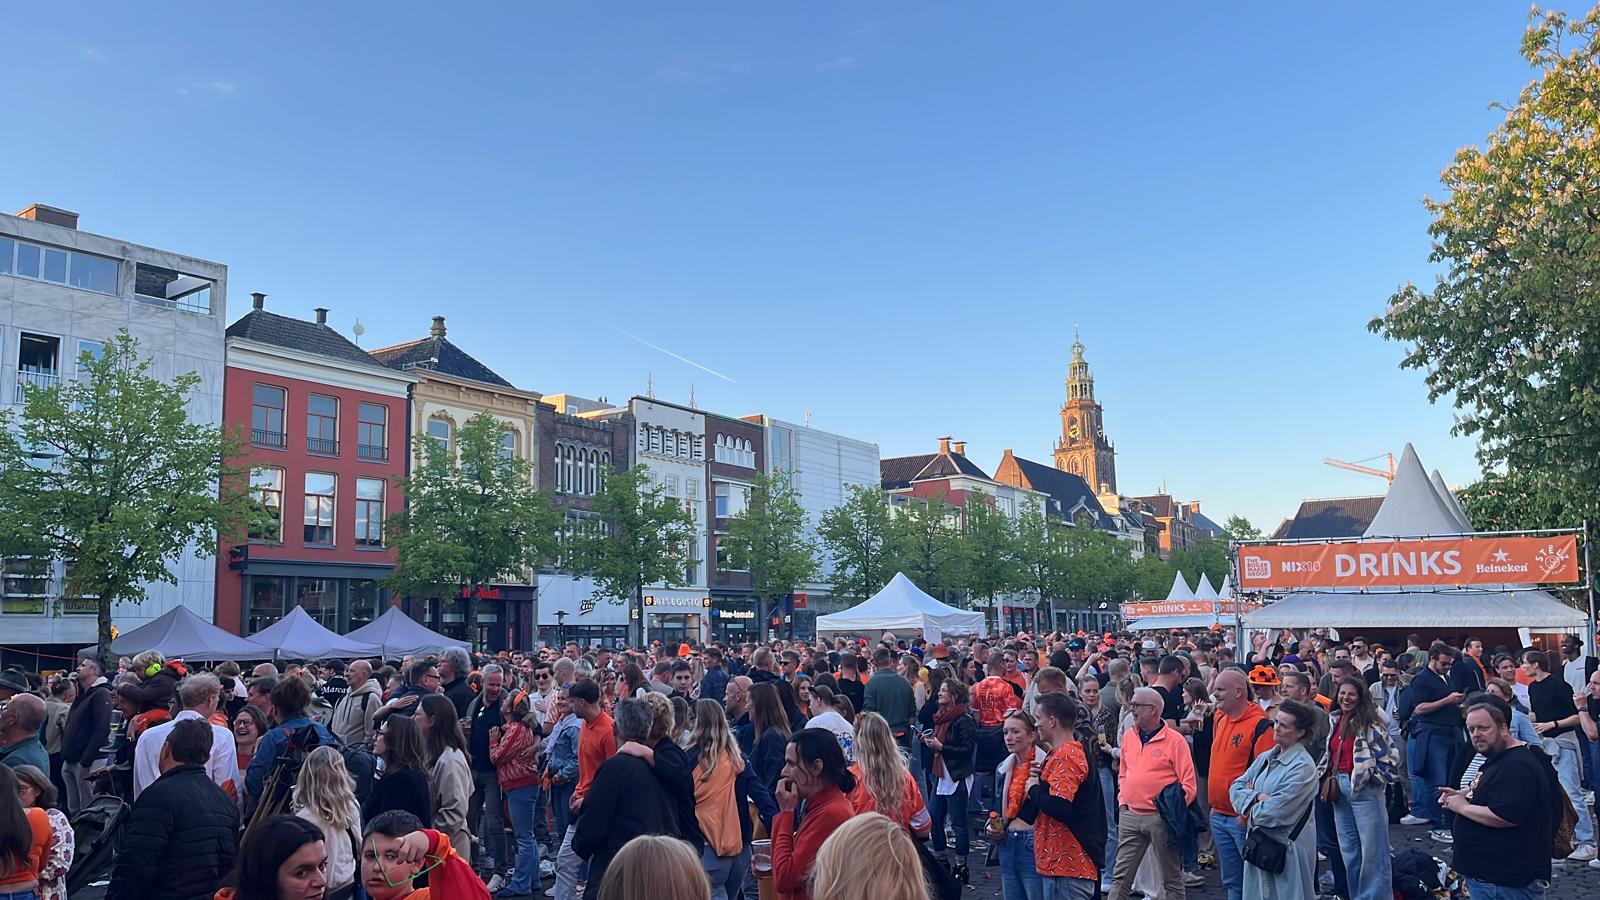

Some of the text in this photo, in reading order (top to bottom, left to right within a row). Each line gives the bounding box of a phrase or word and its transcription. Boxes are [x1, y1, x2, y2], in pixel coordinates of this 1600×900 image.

[1335, 551, 1462, 577] DRINKS
[1476, 564, 1528, 573] Heineken
[1152, 604, 1186, 613] DRINKS
